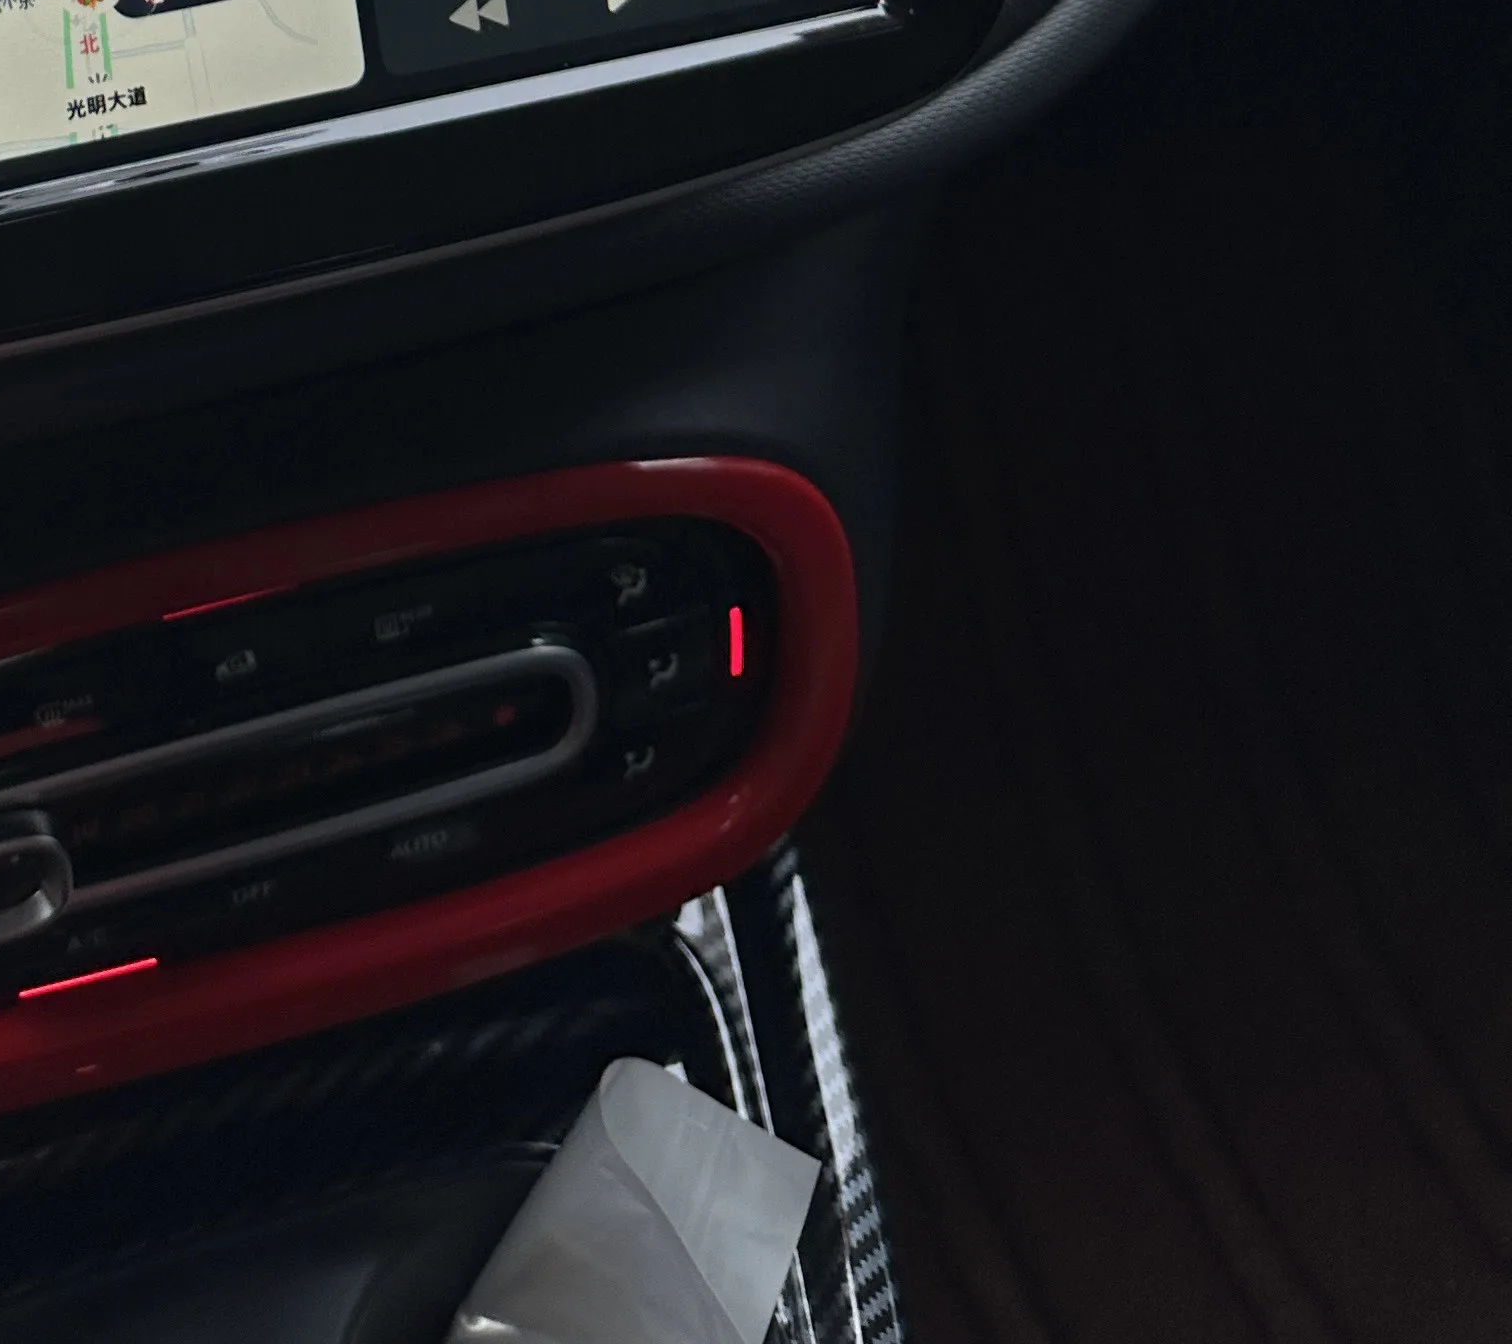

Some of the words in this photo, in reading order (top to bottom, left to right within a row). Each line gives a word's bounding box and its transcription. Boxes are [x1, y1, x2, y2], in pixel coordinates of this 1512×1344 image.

[80, 32, 100, 55] 北
[67, 85, 147, 120] 光明大道
[390, 830, 449, 860] AUTO
